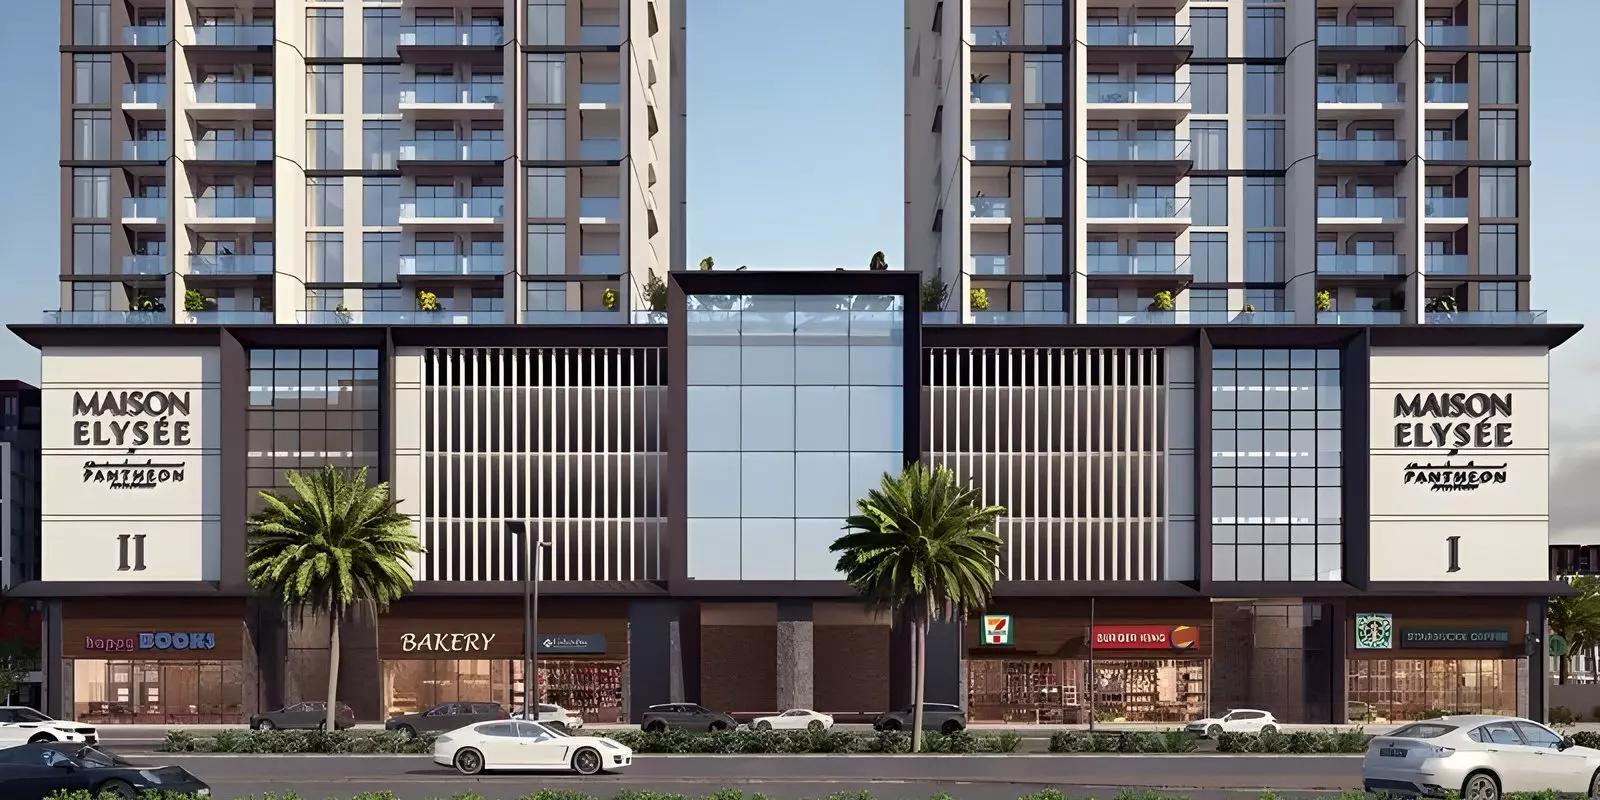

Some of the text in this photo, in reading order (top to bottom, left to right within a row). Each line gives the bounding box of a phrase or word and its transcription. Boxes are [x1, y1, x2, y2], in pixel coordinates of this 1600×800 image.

[72, 391, 190, 417] MAISON
[1394, 392, 1512, 418] MAISON
[73, 415, 191, 446] ELYSÉE
[1394, 417, 1513, 447] ELYSÉE
[83, 469, 185, 483] PANTHEON
[1404, 471, 1507, 484] PANTHEON
[116, 534, 146, 571] II
[400, 633, 495, 652] BAKERY
